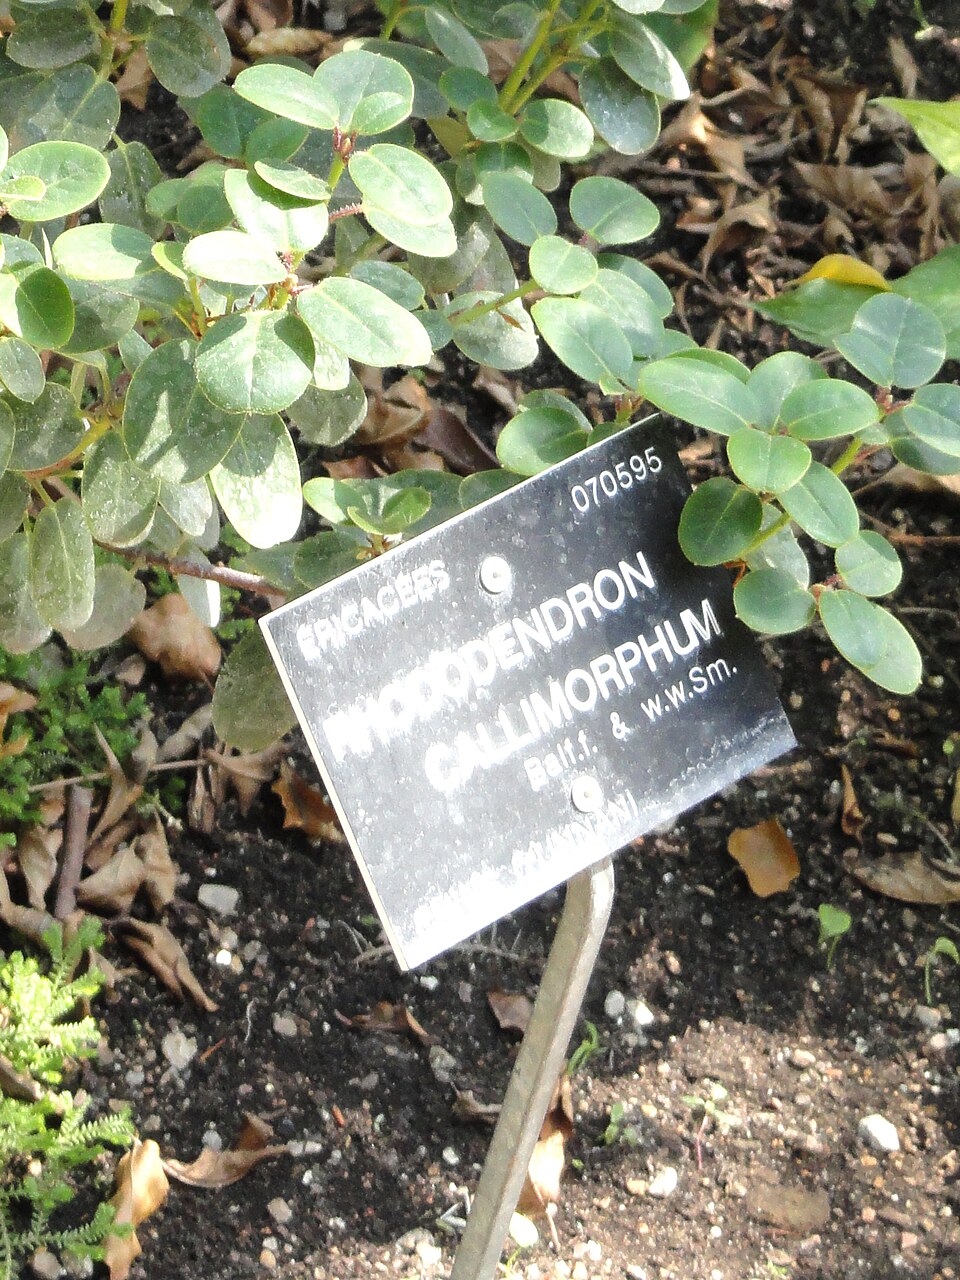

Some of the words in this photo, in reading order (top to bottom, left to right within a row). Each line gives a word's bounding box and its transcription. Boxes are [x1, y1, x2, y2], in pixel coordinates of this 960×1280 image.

[571, 447, 662, 512] 070595
[323, 551, 656, 762] RHODODENDRON
[424, 599, 721, 790] CALLIMORPHUM
[610, 711, 631, 740] &
